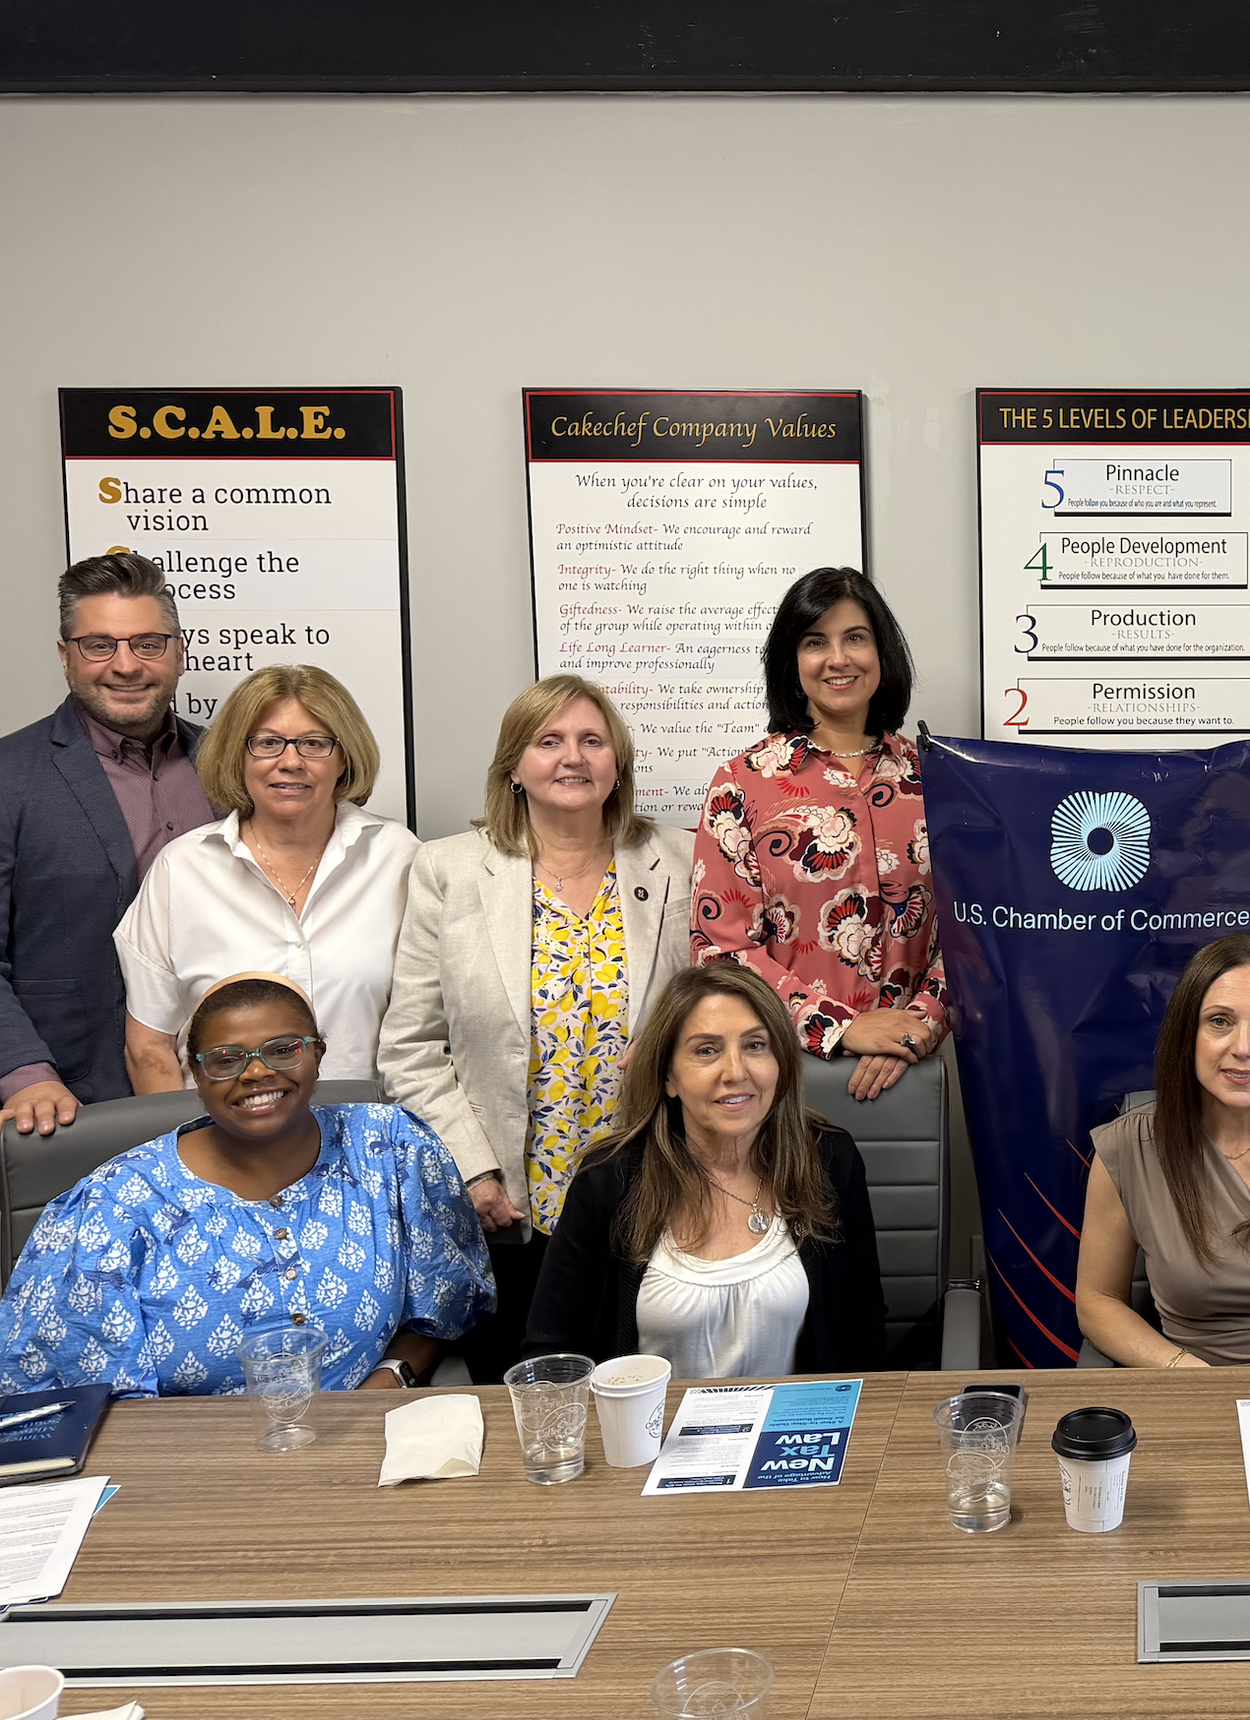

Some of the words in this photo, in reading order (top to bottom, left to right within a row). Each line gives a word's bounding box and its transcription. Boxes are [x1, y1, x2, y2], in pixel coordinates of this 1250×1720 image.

[108, 405, 345, 439] S.C.A.L.E.
[998, 408, 1037, 428] THE
[1042, 408, 1052, 428] 5
[1059, 408, 1126, 428] LEVELS
[1131, 408, 1157, 428] OF
[551, 411, 650, 446] Cakechef
[652, 416, 757, 448] Company
[764, 412, 836, 438] Values
[1106, 464, 1179, 481] Pinnacle
[98, 476, 181, 503] Share
[192, 488, 205, 503] a
[214, 488, 331, 504] common
[574, 471, 615, 486] When
[620, 475, 664, 494] you're
[669, 471, 704, 487] clear
[708, 478, 725, 487] on
[730, 478, 765, 495] your
[769, 472, 816, 490] values,
[1041, 470, 1064, 508] 5
[1109, 484, 1174, 494] -RESPECT-
[626, 492, 688, 507] decisions
[694, 498, 716, 507] are
[721, 494, 766, 514] simple
[126, 509, 208, 530] vision
[555, 523, 600, 534] Positive
[604, 521, 657, 533] Mindset-
[662, 523, 680, 535] We
[683, 526, 740, 538] encourage
[744, 521, 769, 534] and
[771, 521, 813, 534] reward
[575, 539, 632, 555] optimistic
[636, 538, 682, 550] attitude
[1062, 536, 1114, 557] People
[1120, 536, 1226, 557] Development
[1023, 542, 1053, 581] 4
[1084, 556, 1202, 567] -REPRODUCTION-
[557, 564, 615, 576] Integrity-
[619, 564, 637, 575] We
[641, 562, 654, 574] do
[658, 562, 676, 574] the
[680, 562, 709, 579] right
[713, 562, 743, 579] thing
[748, 562, 777, 574] when
[781, 567, 796, 576] no
[166, 582, 236, 600] ocess
[558, 582, 577, 590] one
[582, 580, 590, 590] is
[594, 580, 646, 595] watching
[559, 602, 621, 618] Giftedness-
[626, 604, 643, 614] We
[648, 604, 674, 614] raise
[679, 601, 696, 614] the
[700, 606, 743, 617] average
[1091, 608, 1195, 626] Production
[219, 623, 296, 648] speak
[304, 626, 329, 644] to
[560, 618, 573, 636] of
[574, 619, 592, 632] the
[594, 622, 629, 635] group
[632, 618, 662, 630] while
[665, 620, 720, 635] operating
[724, 618, 761, 630] within
[1014, 614, 1038, 653] 3
[1111, 629, 1174, 639] -RESULTS-
[559, 641, 584, 656] Life
[586, 641, 615, 657] Long
[619, 642, 670, 653] Learner-
[675, 642, 692, 653] An
[697, 646, 750, 658] eagerness
[559, 656, 582, 668] and
[586, 658, 632, 673] improve
[635, 657, 715, 674] professionally
[657, 683, 674, 694] We
[678, 681, 702, 694] take
[706, 682, 764, 698] ownership
[1093, 683, 1194, 699] Permission
[186, 692, 218, 719] by
[620, 698, 703, 715] responsibilities
[707, 698, 731, 709] and
[1003, 688, 1030, 726] 2
[1087, 702, 1199, 712] -RELATIONSHIPS-
[639, 723, 657, 733] We
[660, 721, 691, 733] value
[695, 721, 712, 733] the
[716, 720, 759, 733] "Team"
[1053, 716, 1084, 726] People
[1086, 715, 1114, 724] follow
[1116, 718, 1133, 726] you
[1136, 716, 1173, 724] because
[1175, 716, 1195, 726] they
[657, 746, 673, 756] We
[675, 748, 696, 761] put
[954, 901, 986, 925] U.S.
[992, 905, 1096, 930] Chamber
[1101, 909, 1124, 930] of
[1130, 909, 1249, 930] Commerce
[775, 1432, 840, 1445] Law
[780, 1445, 835, 1458] Tax
[760, 1457, 835, 1472] New
